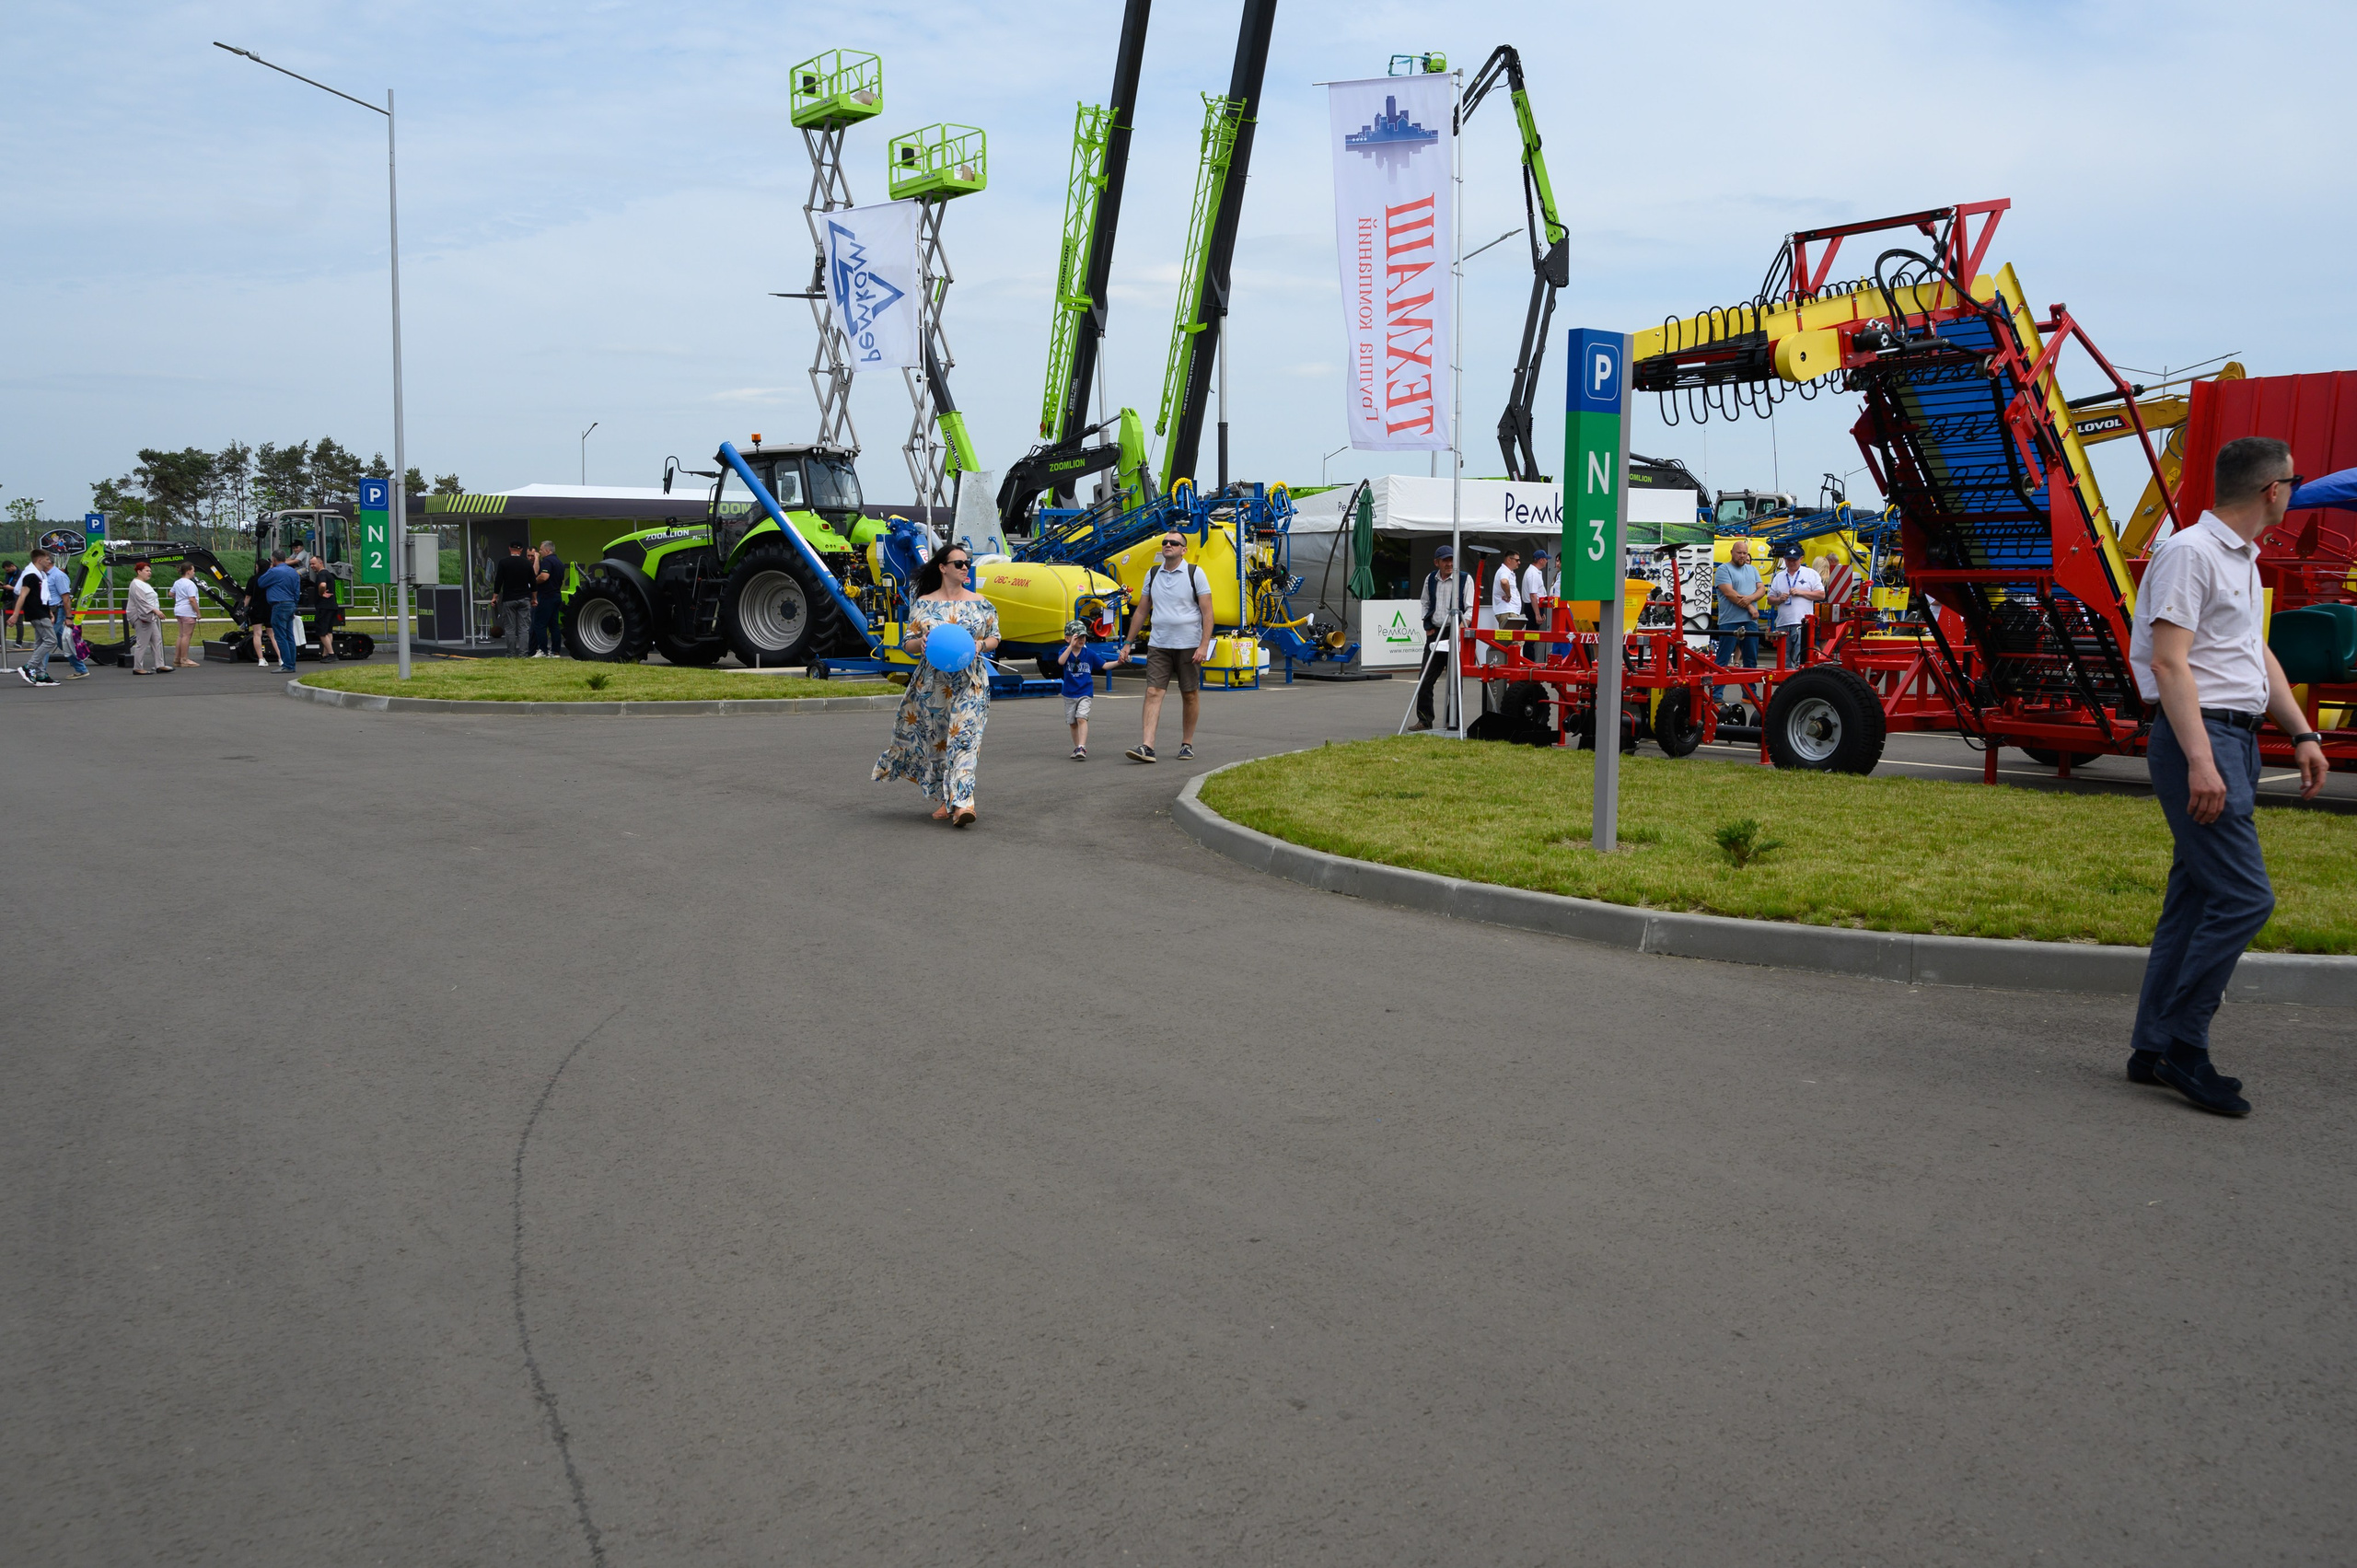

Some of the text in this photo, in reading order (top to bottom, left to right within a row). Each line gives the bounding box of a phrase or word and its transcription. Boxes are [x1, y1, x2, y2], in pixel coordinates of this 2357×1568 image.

[1059, 244, 1071, 296] ZOOMLION
[1595, 354, 1612, 390] P
[2077, 418, 2122, 434] LOVOL
[944, 429, 963, 469] ZOOMLION
[1049, 458, 1086, 472] ZOOMLION
[1587, 450, 1610, 495] N
[1629, 473, 1653, 483] OMLION
[369, 487, 382, 503] P
[1504, 491, 1564, 525] Ремк
[368, 525, 384, 543] N
[1587, 519, 1606, 562] 3
[150, 555, 184, 563] ZOOMLION
[370, 551, 383, 569] 2
[1377, 622, 1416, 636] Ремком
